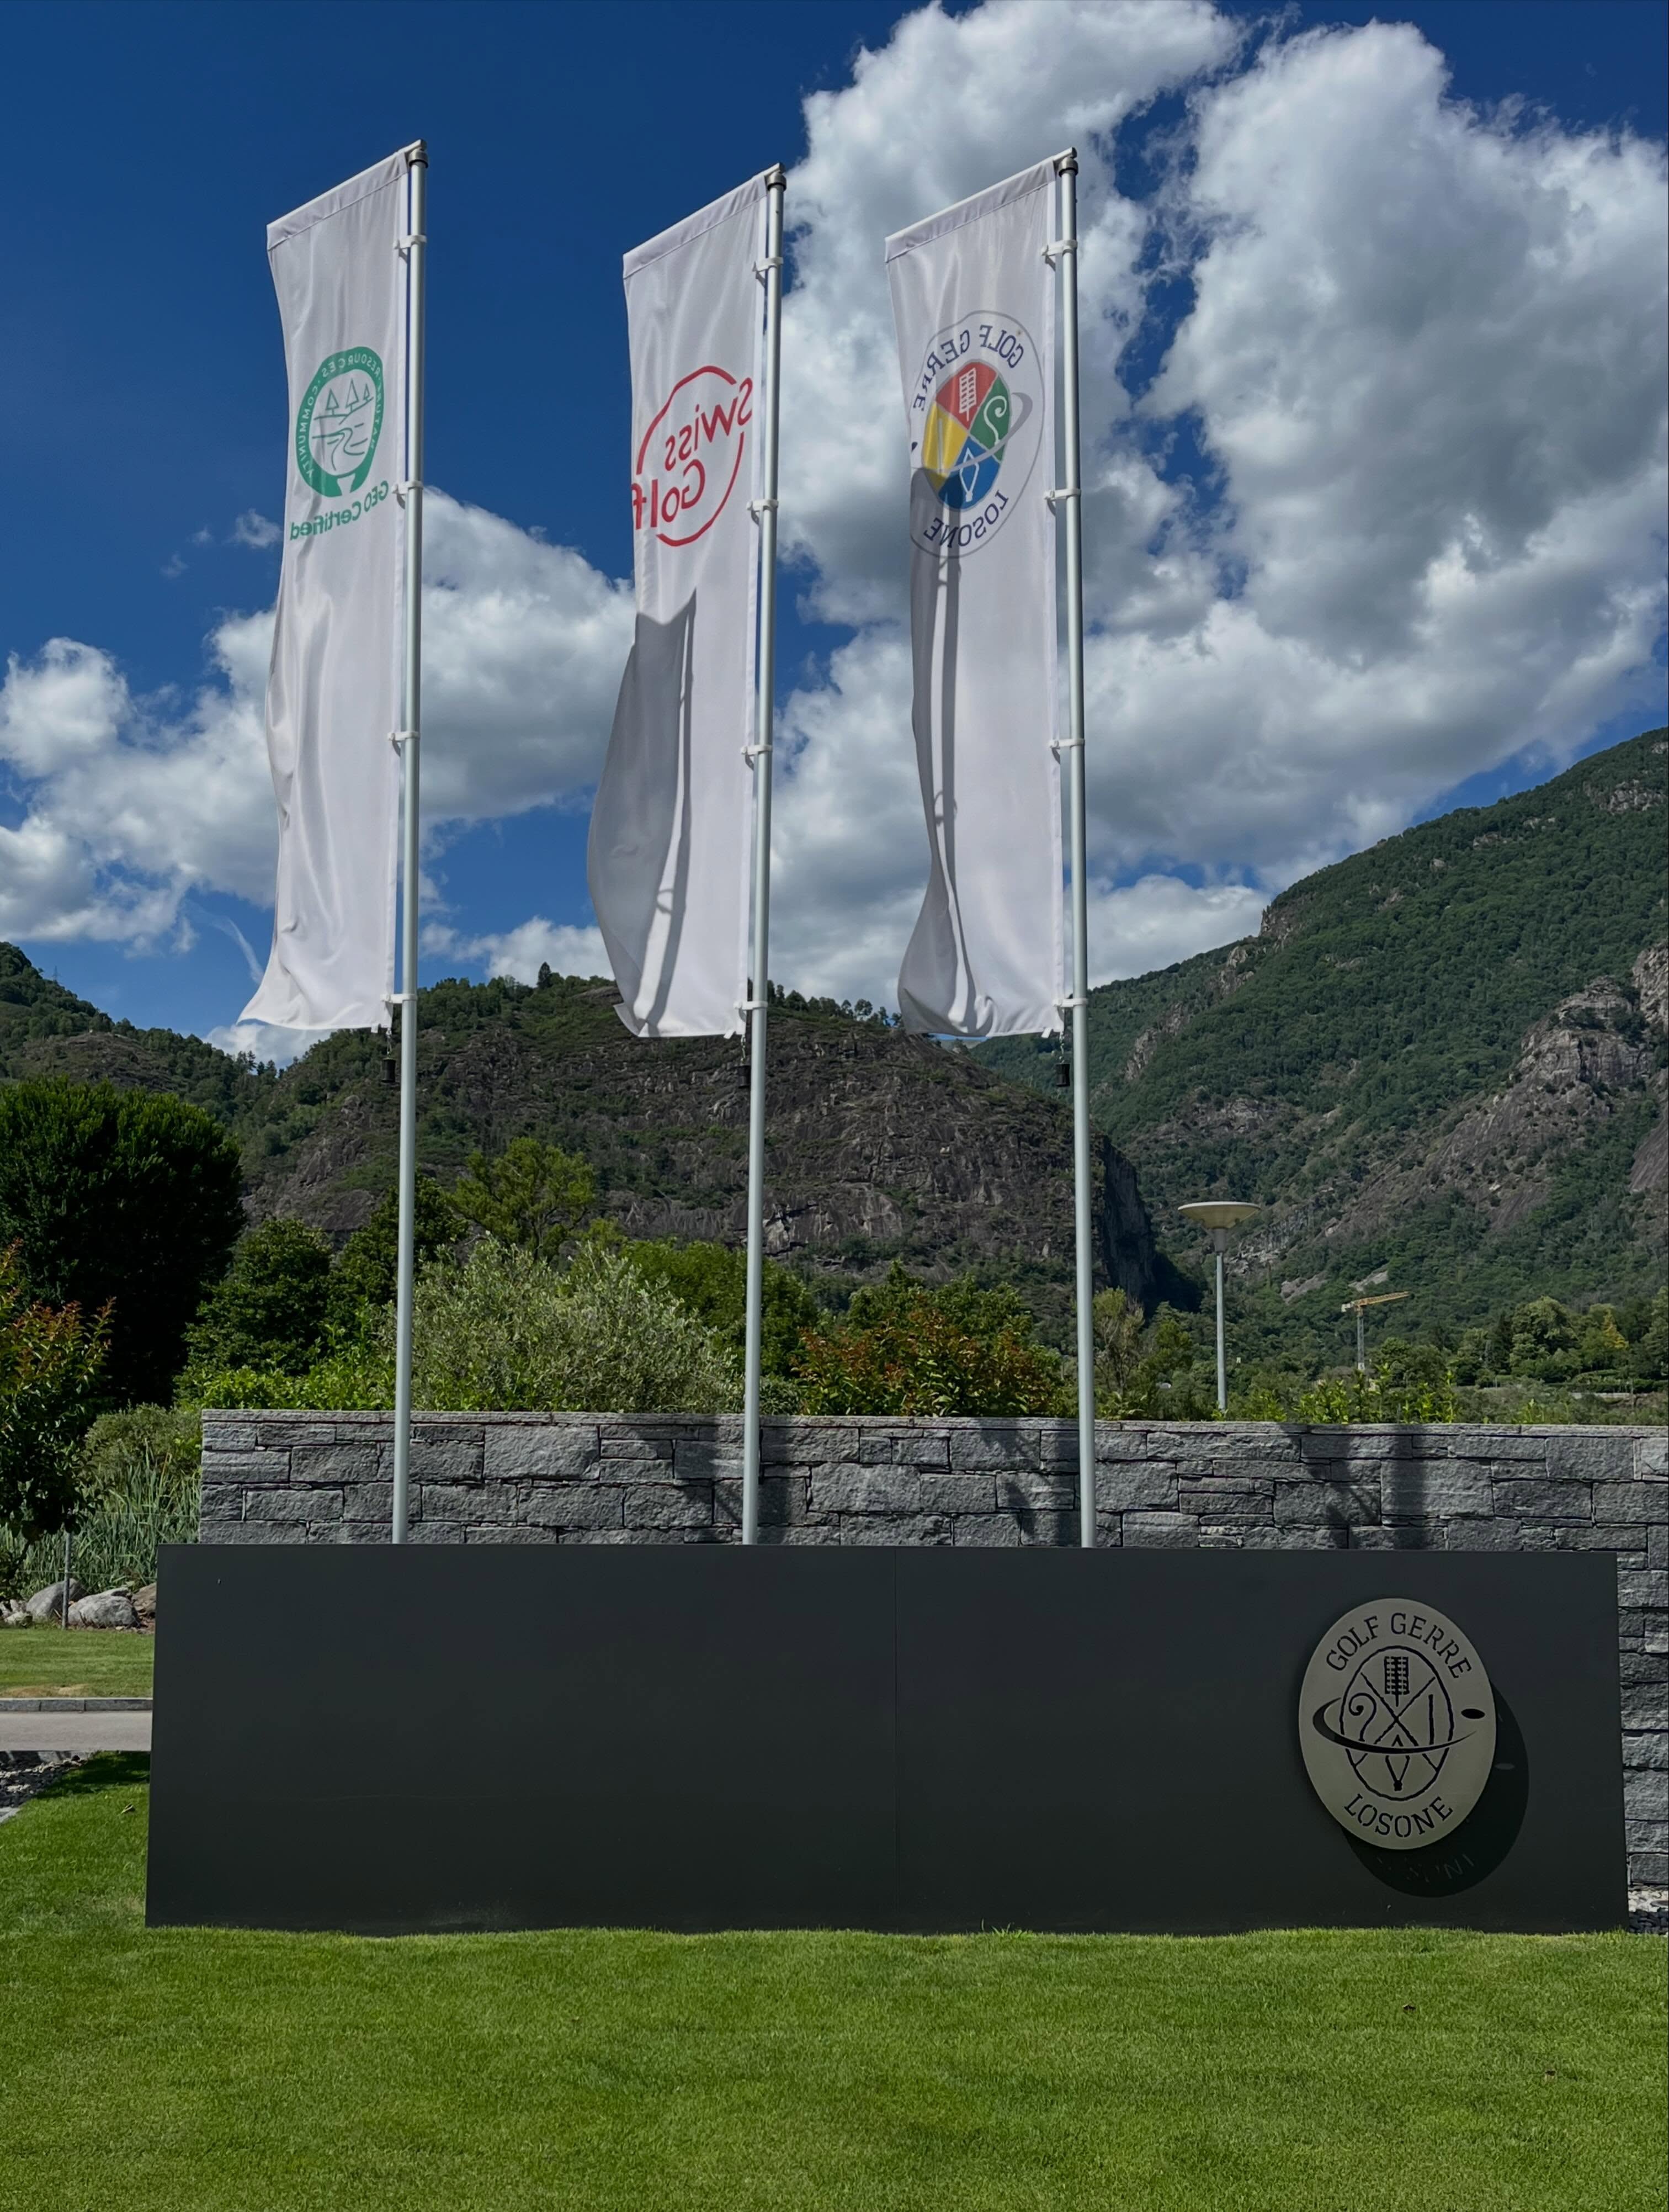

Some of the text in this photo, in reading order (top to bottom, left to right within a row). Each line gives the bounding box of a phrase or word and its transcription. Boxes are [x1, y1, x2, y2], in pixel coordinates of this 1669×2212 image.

[1326, 1612, 1472, 1679] GOLF GERRE
[1344, 1794, 1453, 1838] LOSONE
